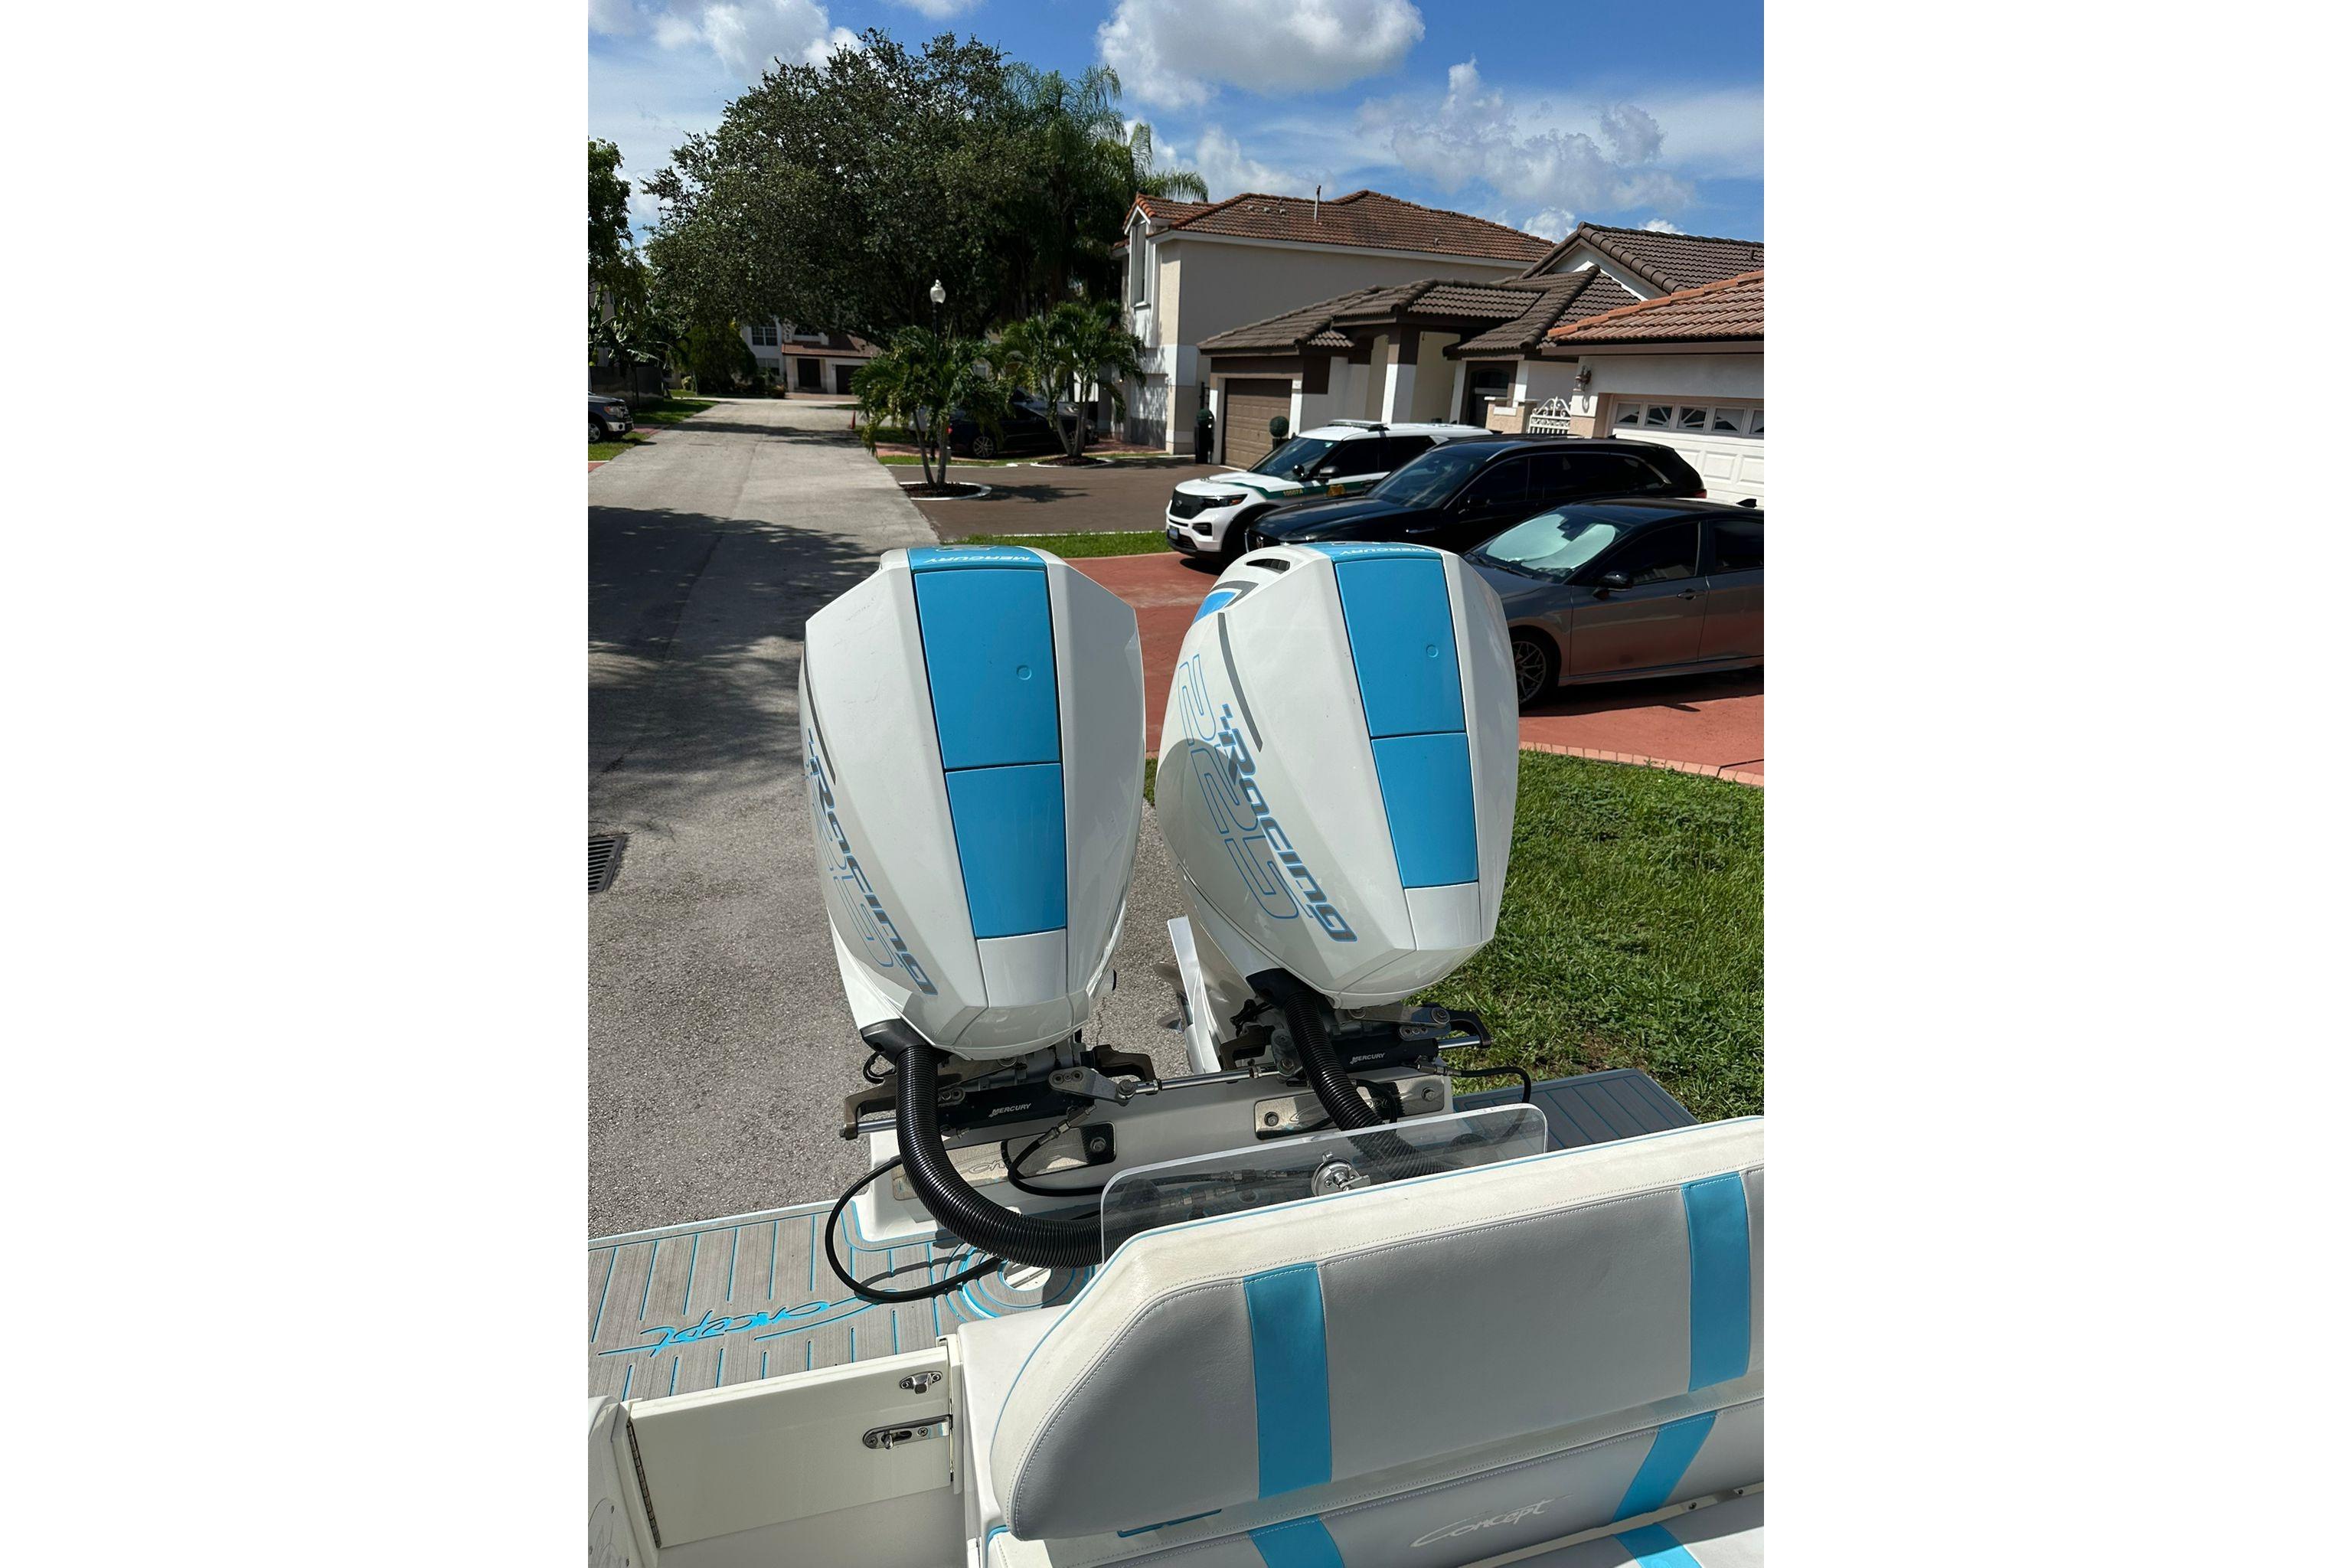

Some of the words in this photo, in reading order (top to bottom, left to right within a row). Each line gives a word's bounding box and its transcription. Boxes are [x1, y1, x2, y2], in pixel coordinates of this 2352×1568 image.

[1340, 547, 1426, 556] MERCURY
[1217, 712, 1358, 943] Racing
[808, 741, 939, 996] Racing
[1350, 1052, 1385, 1065] MERCURY
[988, 1102, 1032, 1118] MERCURY
[1409, 1493, 1575, 1547] Concept
